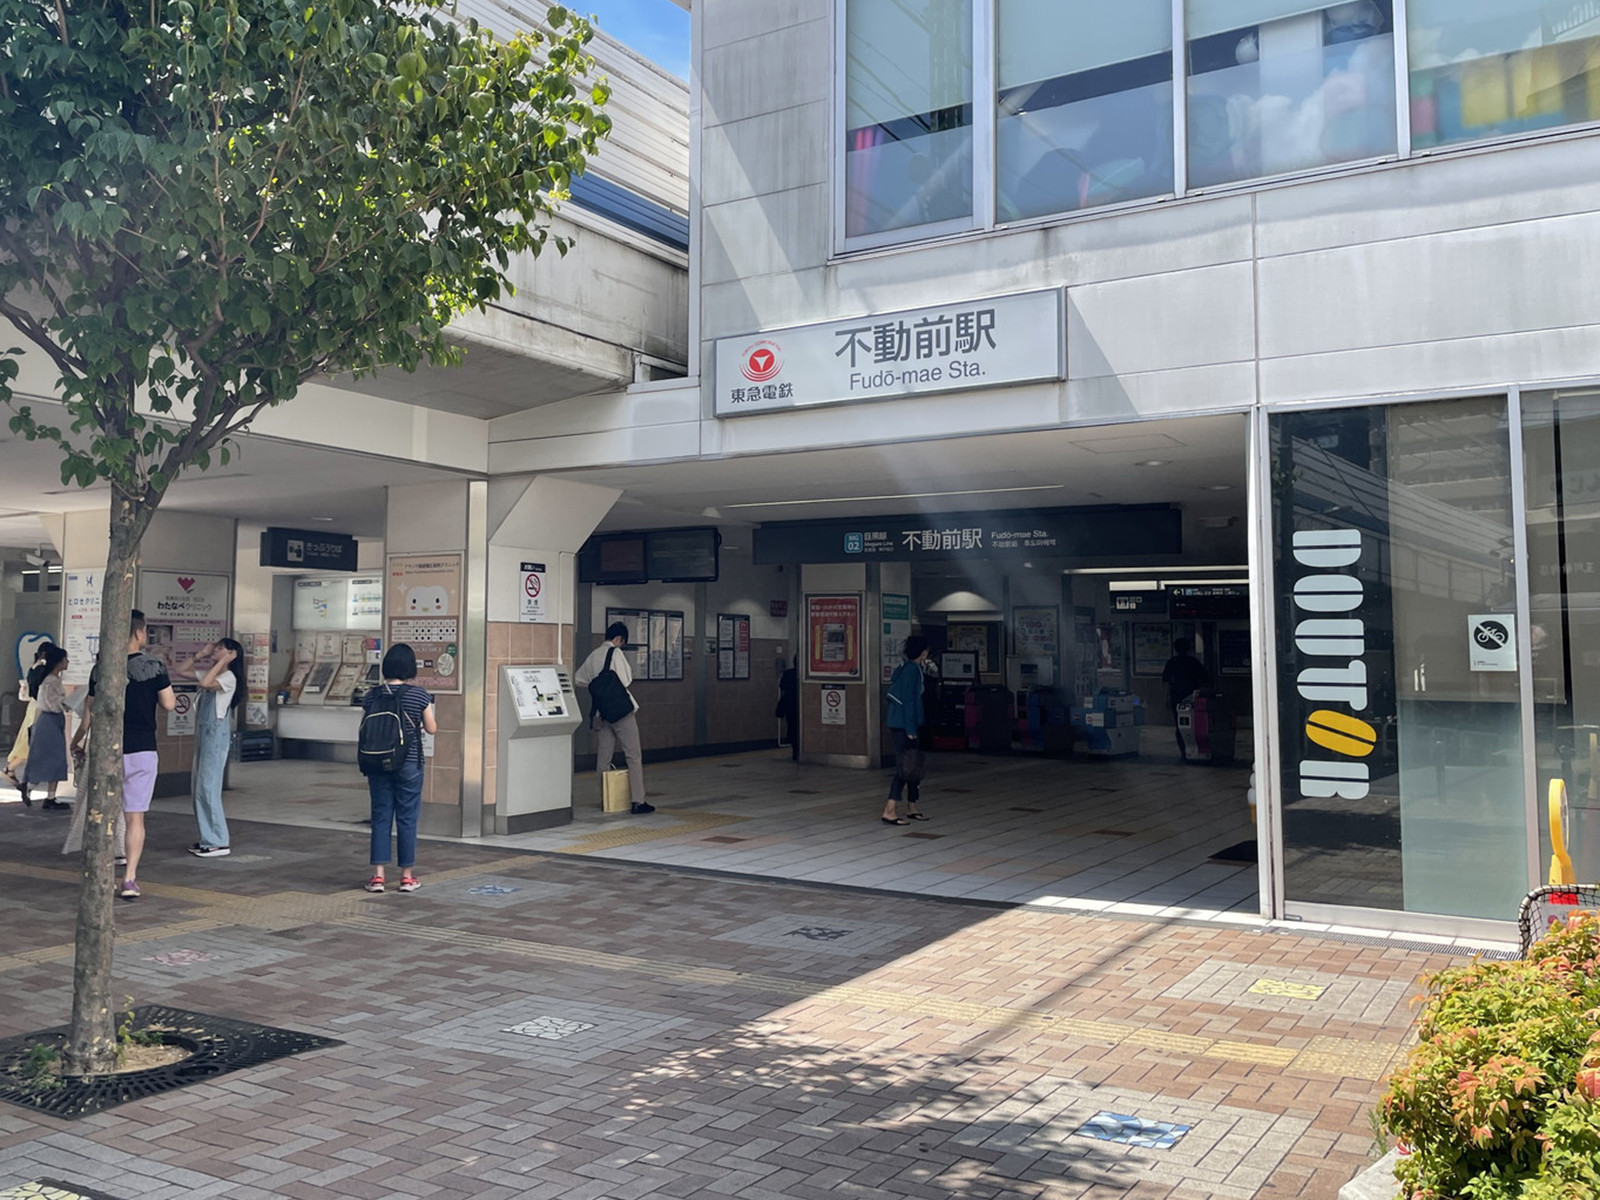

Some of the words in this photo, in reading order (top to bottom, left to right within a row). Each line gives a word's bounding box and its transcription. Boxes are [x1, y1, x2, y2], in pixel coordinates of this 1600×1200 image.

[835, 309, 997, 368] 不動前駅
[850, 366, 942, 390] Fudō-mae
[949, 360, 986, 379] Sta.
[731, 382, 793, 403] 東急電鉄
[848, 542, 860, 550] 02
[902, 528, 983, 551] 不動前駅
[1292, 529, 1377, 800] DOUTOR
